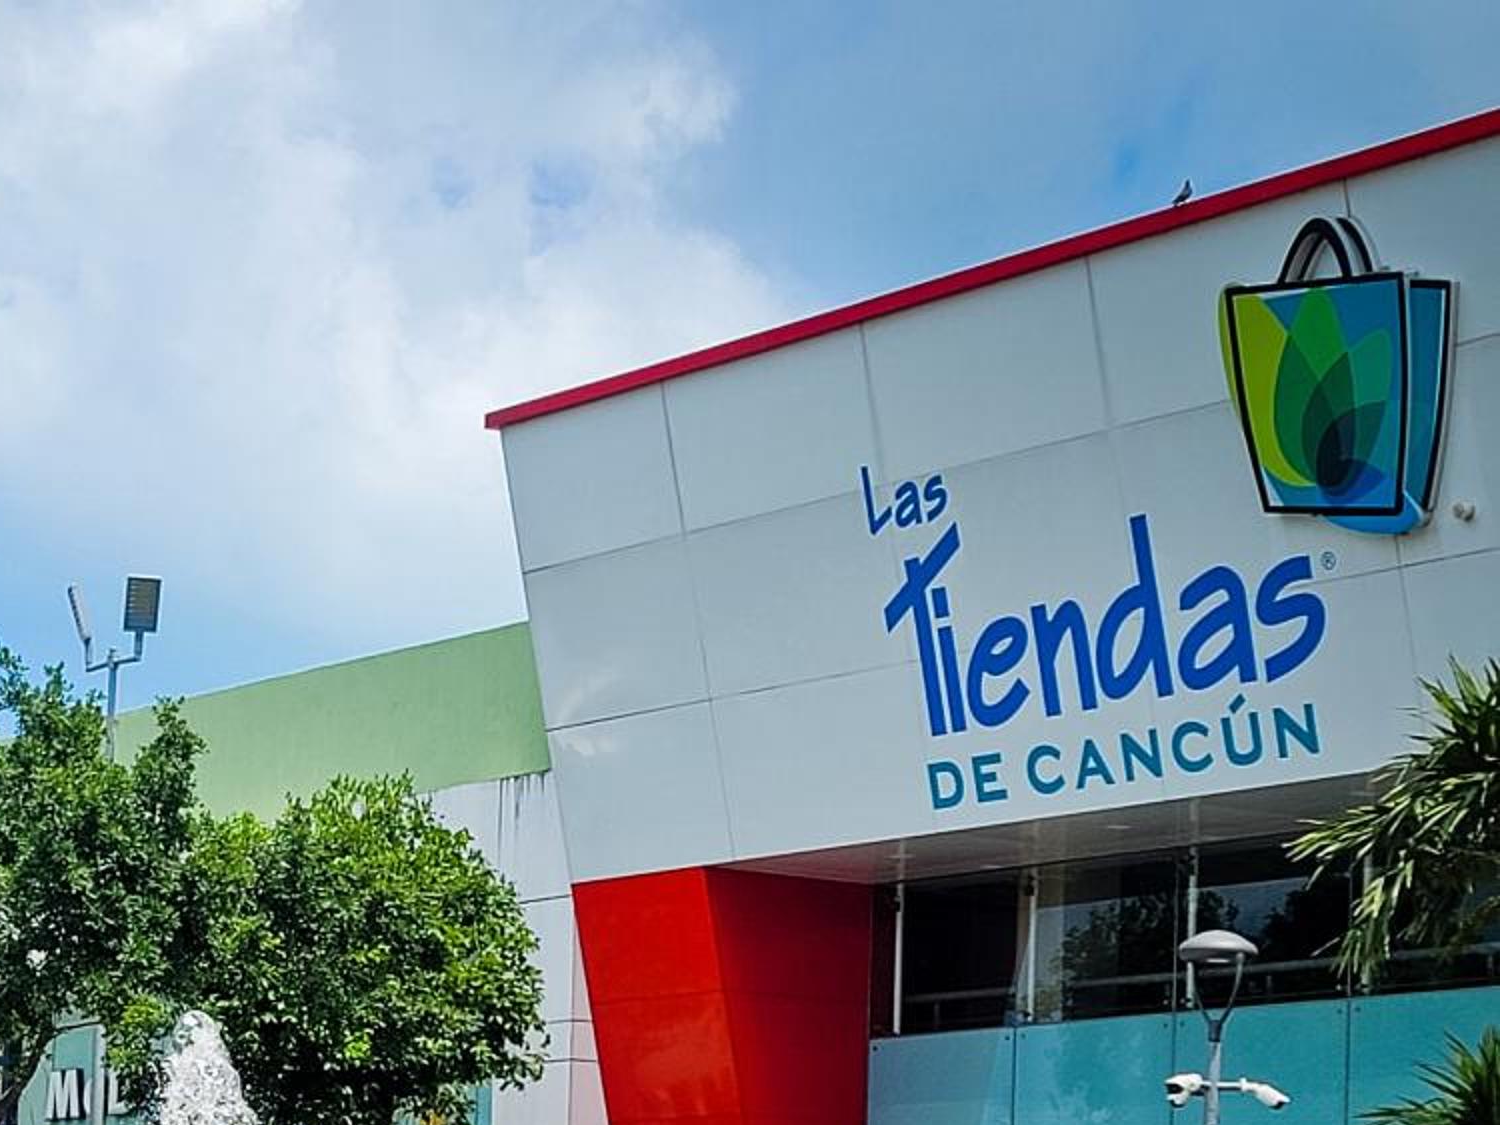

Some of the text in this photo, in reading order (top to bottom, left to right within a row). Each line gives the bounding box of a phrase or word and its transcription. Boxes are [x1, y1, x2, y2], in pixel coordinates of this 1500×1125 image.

[859, 465, 949, 536] Las
[883, 513, 1329, 738] Tiendas
[927, 693, 1322, 810] DE CANCÚN
